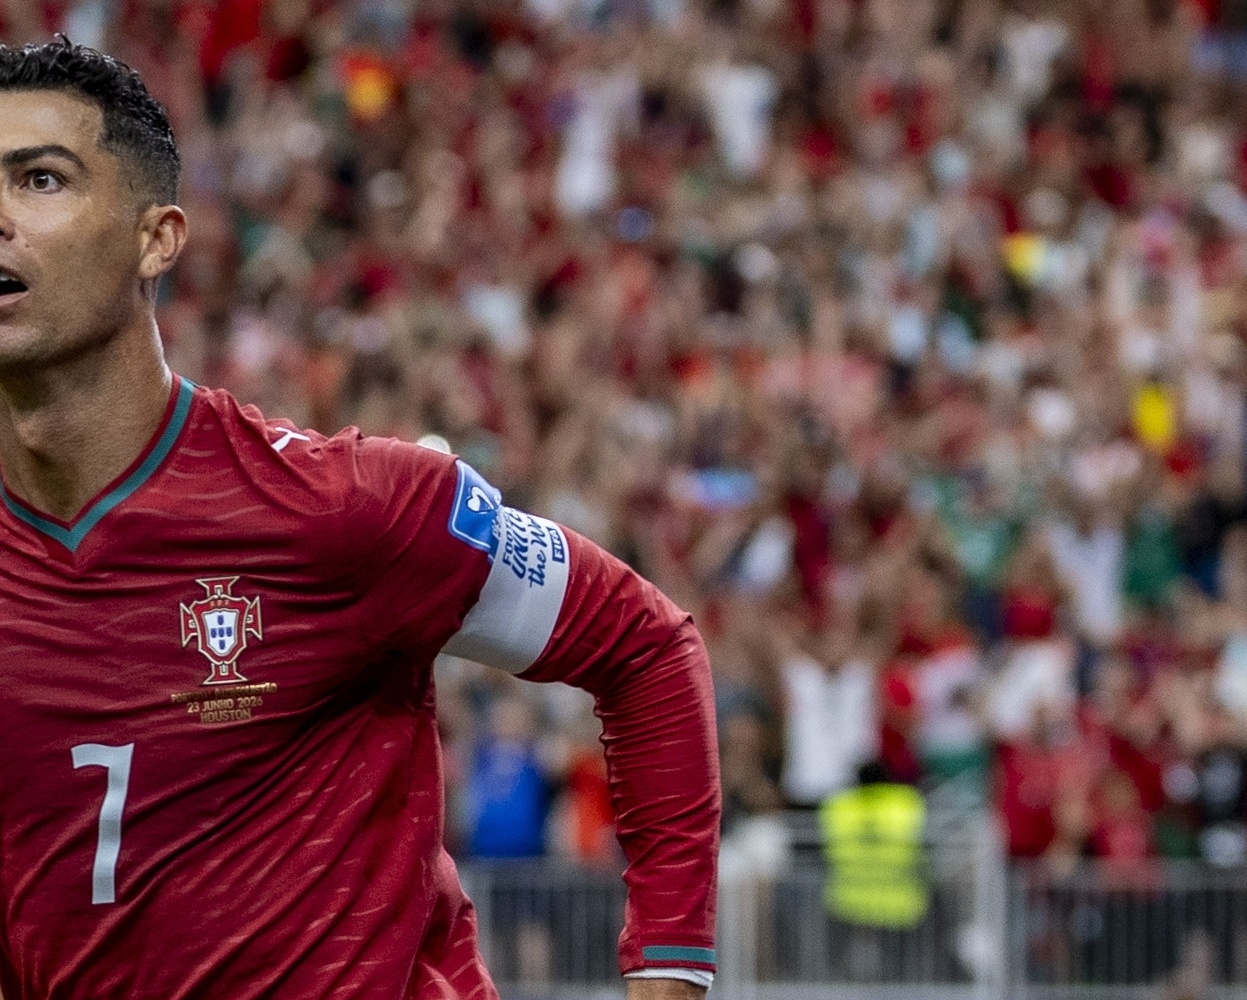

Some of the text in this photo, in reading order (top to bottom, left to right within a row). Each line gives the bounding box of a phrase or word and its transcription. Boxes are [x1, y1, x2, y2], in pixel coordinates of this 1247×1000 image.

[187, 696, 263, 713] 23 JUNHO 2026
[200, 708, 251, 723] HOUSTON
[71, 743, 134, 904] 7
